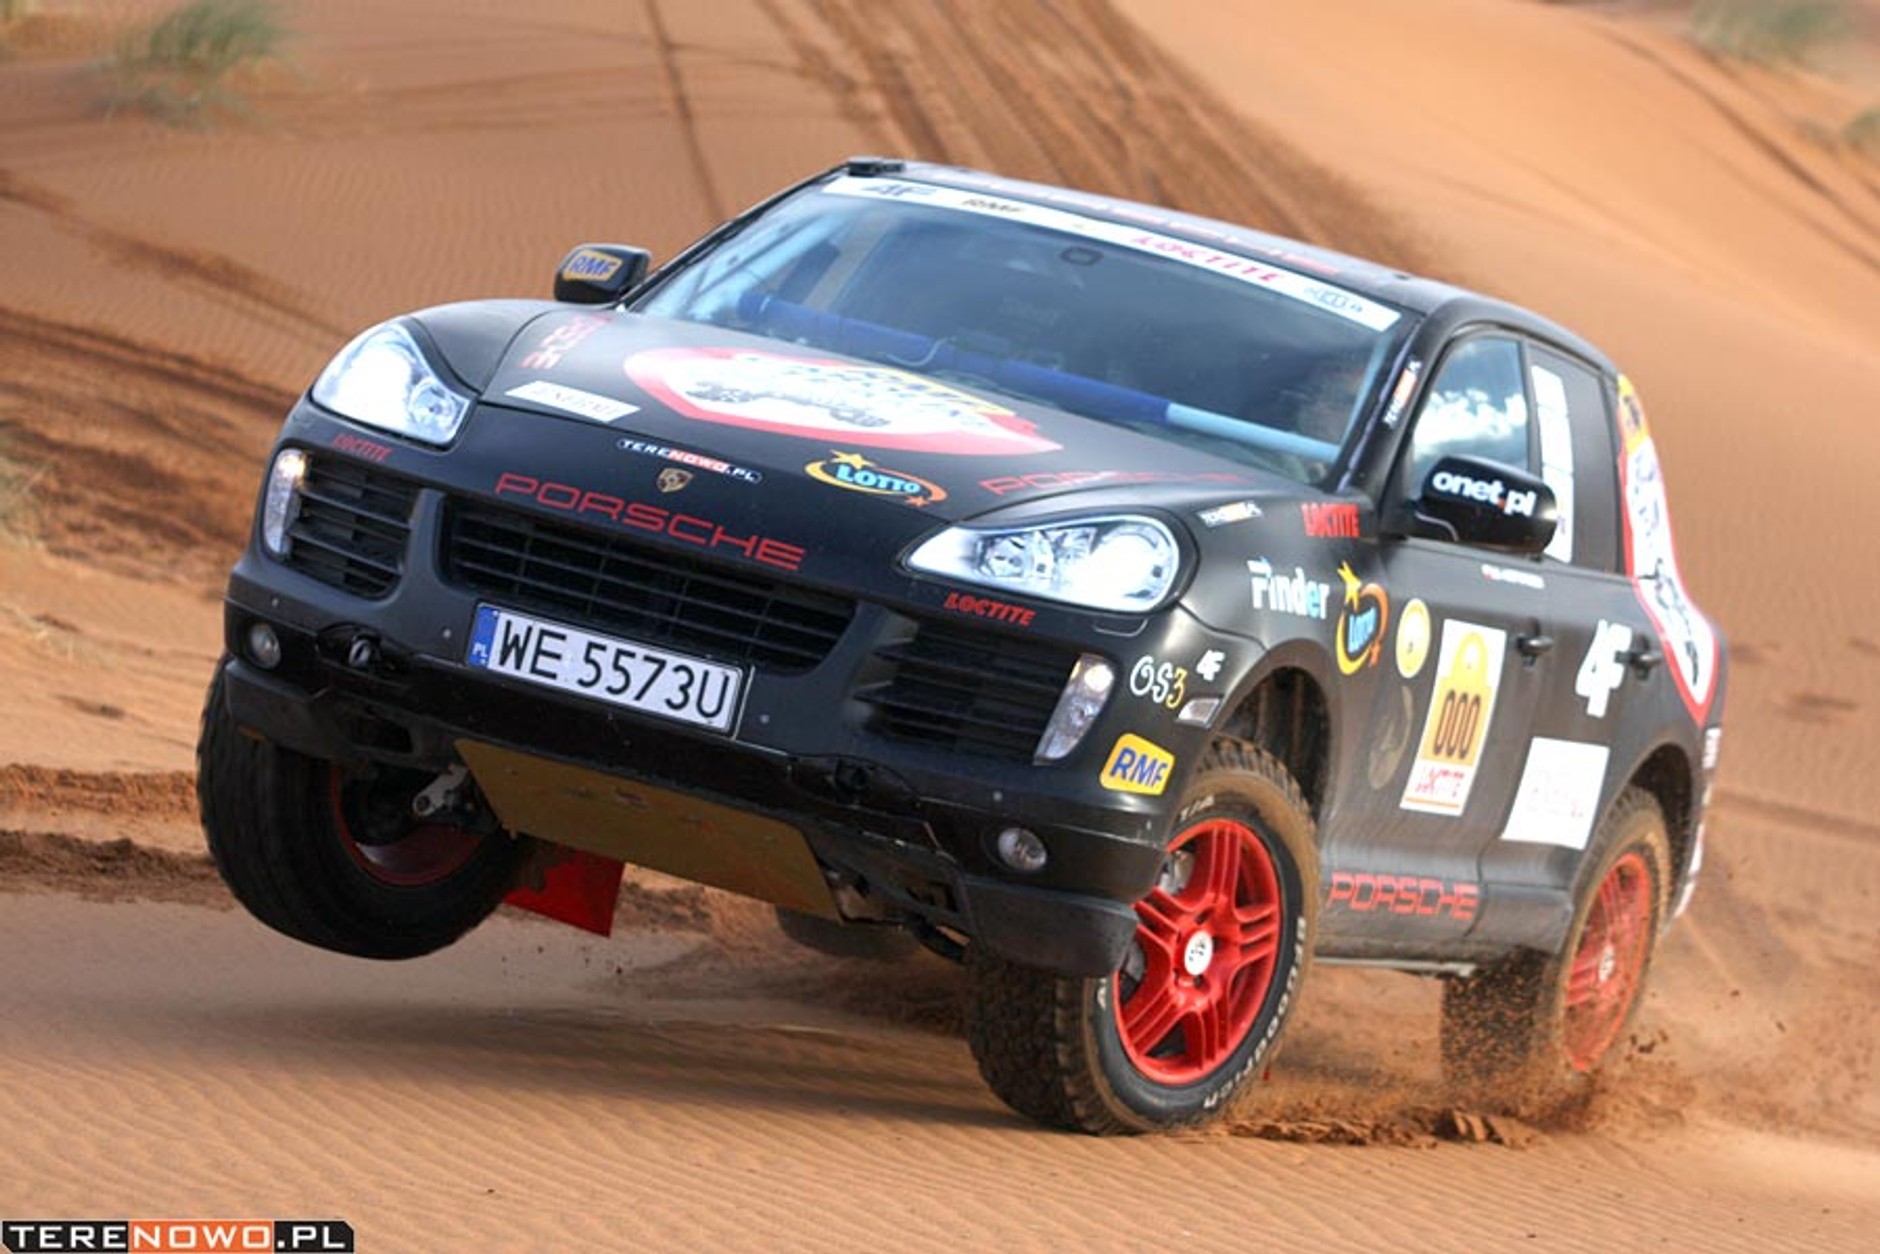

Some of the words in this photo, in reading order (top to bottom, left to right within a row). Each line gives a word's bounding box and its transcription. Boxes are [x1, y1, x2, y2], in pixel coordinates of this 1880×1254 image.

[622, 439, 756, 482] TERENOWO.PL
[836, 463, 922, 495] LOTTO
[1432, 471, 1537, 517] onet.pl
[495, 472, 805, 571] PORSCHE
[943, 592, 1037, 627] LOCTITE
[1247, 556, 1331, 620] Finder
[472, 642, 489, 660] PL
[499, 620, 568, 680] WE
[576, 642, 732, 719] 5573U
[1433, 689, 1482, 760] 000
[1110, 746, 1169, 787] RMF
[1326, 870, 1479, 919] PORSCHE
